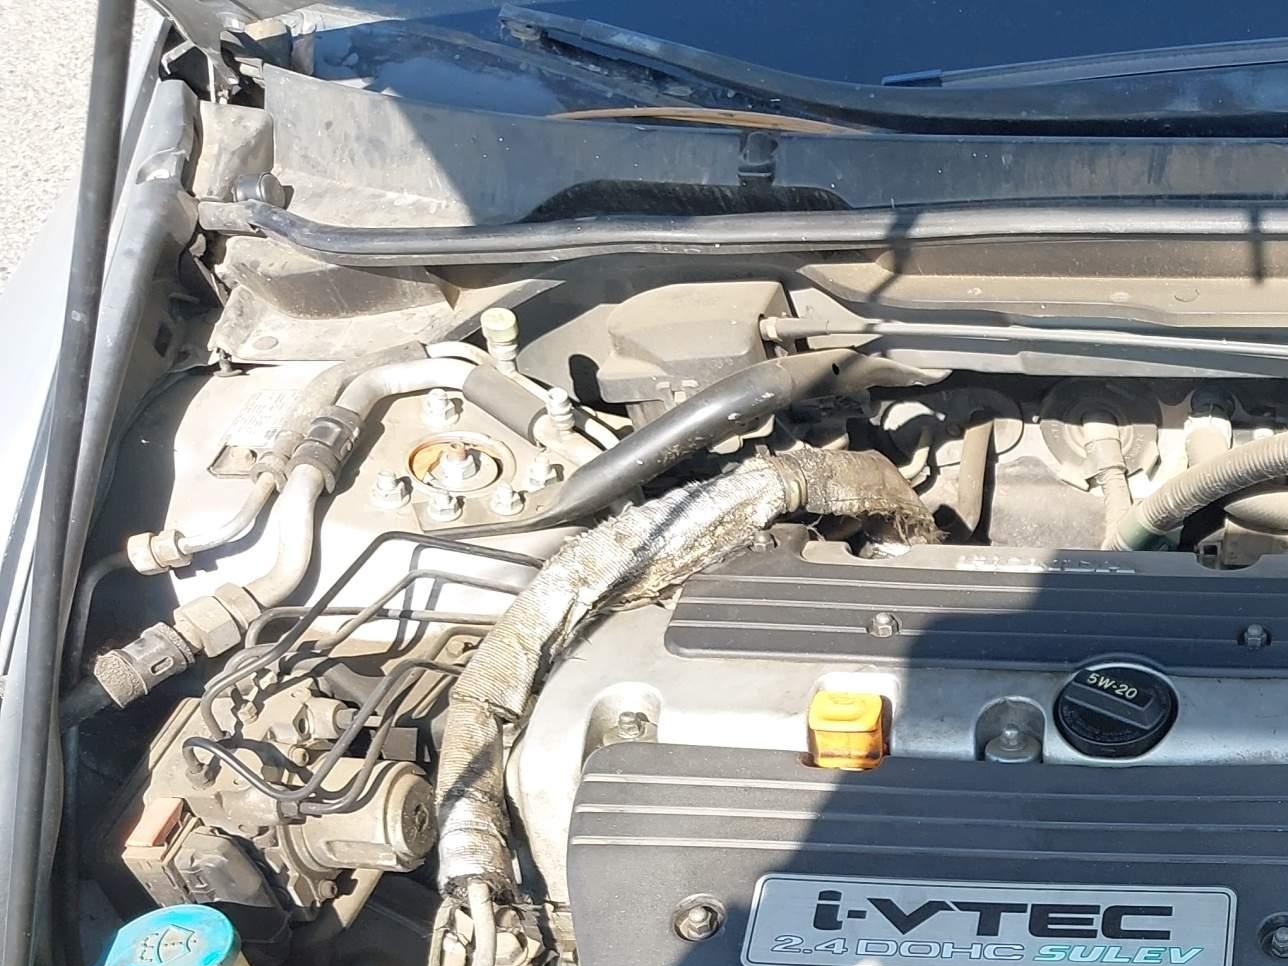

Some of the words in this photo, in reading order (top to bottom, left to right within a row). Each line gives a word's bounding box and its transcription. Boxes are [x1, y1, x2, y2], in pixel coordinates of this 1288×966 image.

[1087, 673, 1137, 699] 5W-20
[813, 890, 1173, 940] i-VTEC
[770, 934, 848, 955] 2.4
[855, 938, 1025, 960] DOHC
[1033, 944, 1204, 964] SULEV
